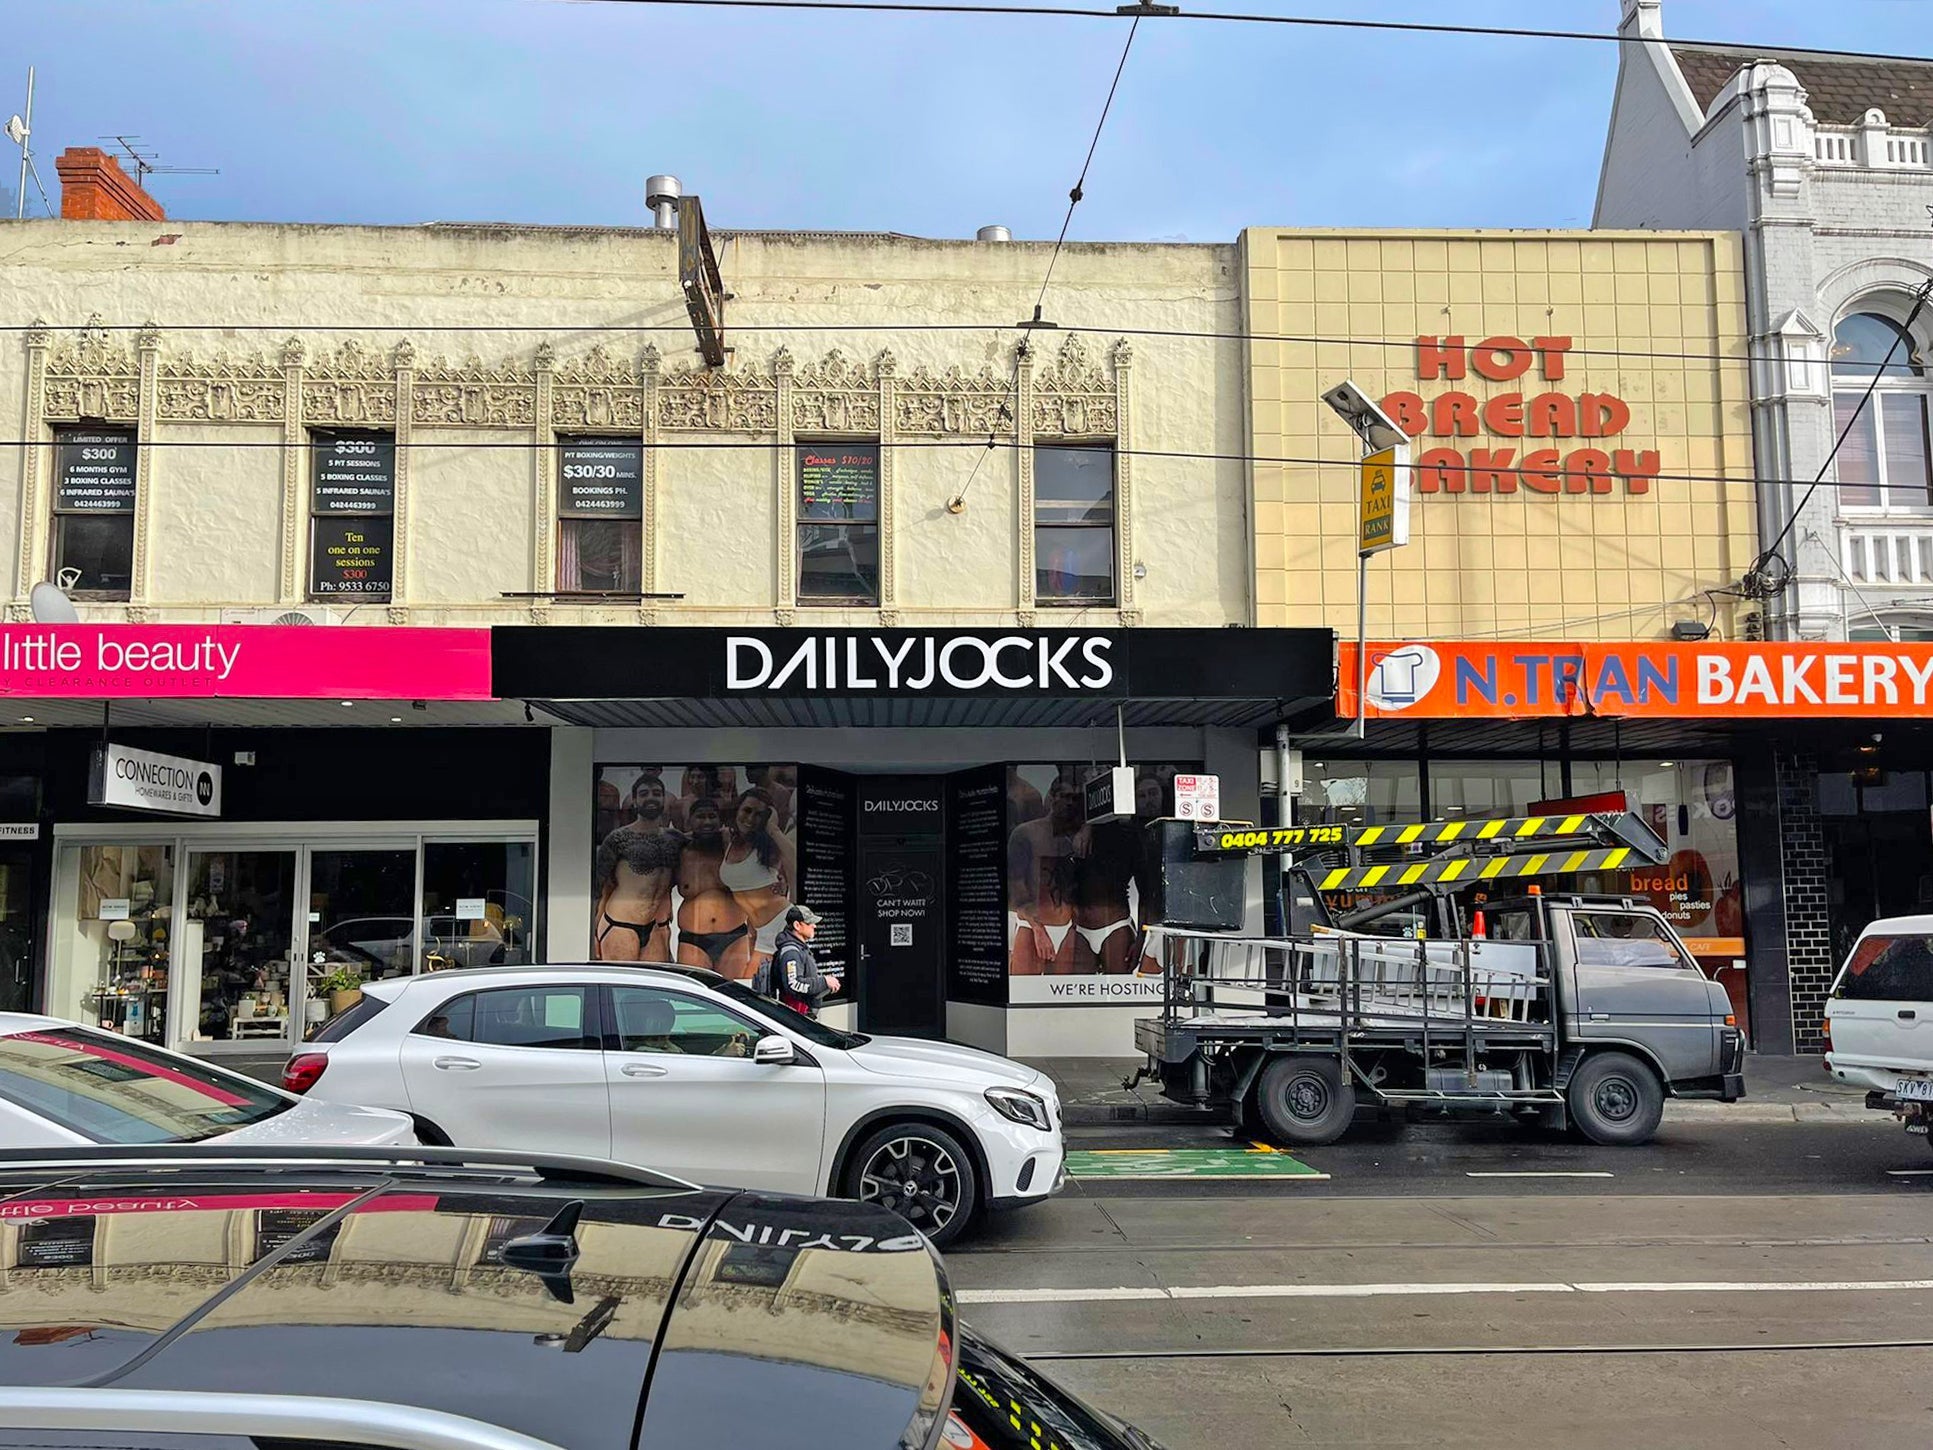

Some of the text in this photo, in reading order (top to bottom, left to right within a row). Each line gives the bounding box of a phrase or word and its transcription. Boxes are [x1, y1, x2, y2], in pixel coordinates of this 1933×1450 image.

[1417, 335, 1573, 381] HOT
[1380, 391, 1630, 437] BREAD
[81, 447, 117, 460] $300
[69, 465, 75, 473] 6
[75, 465, 108, 473] MONTHS
[563, 465, 616, 479] $30/30
[1410, 447, 1661, 495] AKERY
[64, 477, 132, 485] 3 BOXING CLASSES
[326, 473, 355, 481] BOXING
[356, 474, 388, 482] CLASSES
[66, 488, 103, 496] INFRARED
[322, 487, 359, 495] INFRARED
[1365, 494, 1391, 515] TAXI
[1364, 520, 1390, 536] RANK
[344, 532, 364, 542] Ten
[327, 546, 381, 554] one on one
[335, 556, 376, 567] sessions
[342, 569, 368, 579] $300
[320, 581, 390, 591] Ph: 9533 6750
[4, 633, 241, 680] little beauty
[726, 636, 1114, 690] DAILYJOCKS
[25, 677, 131, 688] CLEARANCE
[144, 677, 212, 688] OUTLET
[1697, 655, 1933, 706] BAKERY
[116, 758, 194, 790] CONNECTION
[135, 787, 172, 800] HOMEWARES
[178, 792, 193, 804] GIFTS
[864, 800, 939, 812] DAILYJOCKS
[1221, 827, 1342, 848] 0404 777 725
[1631, 873, 1688, 891] bread
[1669, 891, 1688, 903] pies
[876, 899, 901, 908] CAN'T
[1680, 901, 1711, 911] pasties
[877, 909, 926, 918] SHOP NOW!
[1661, 911, 1691, 920] donuts
[1049, 983, 1095, 996] WE'RE
